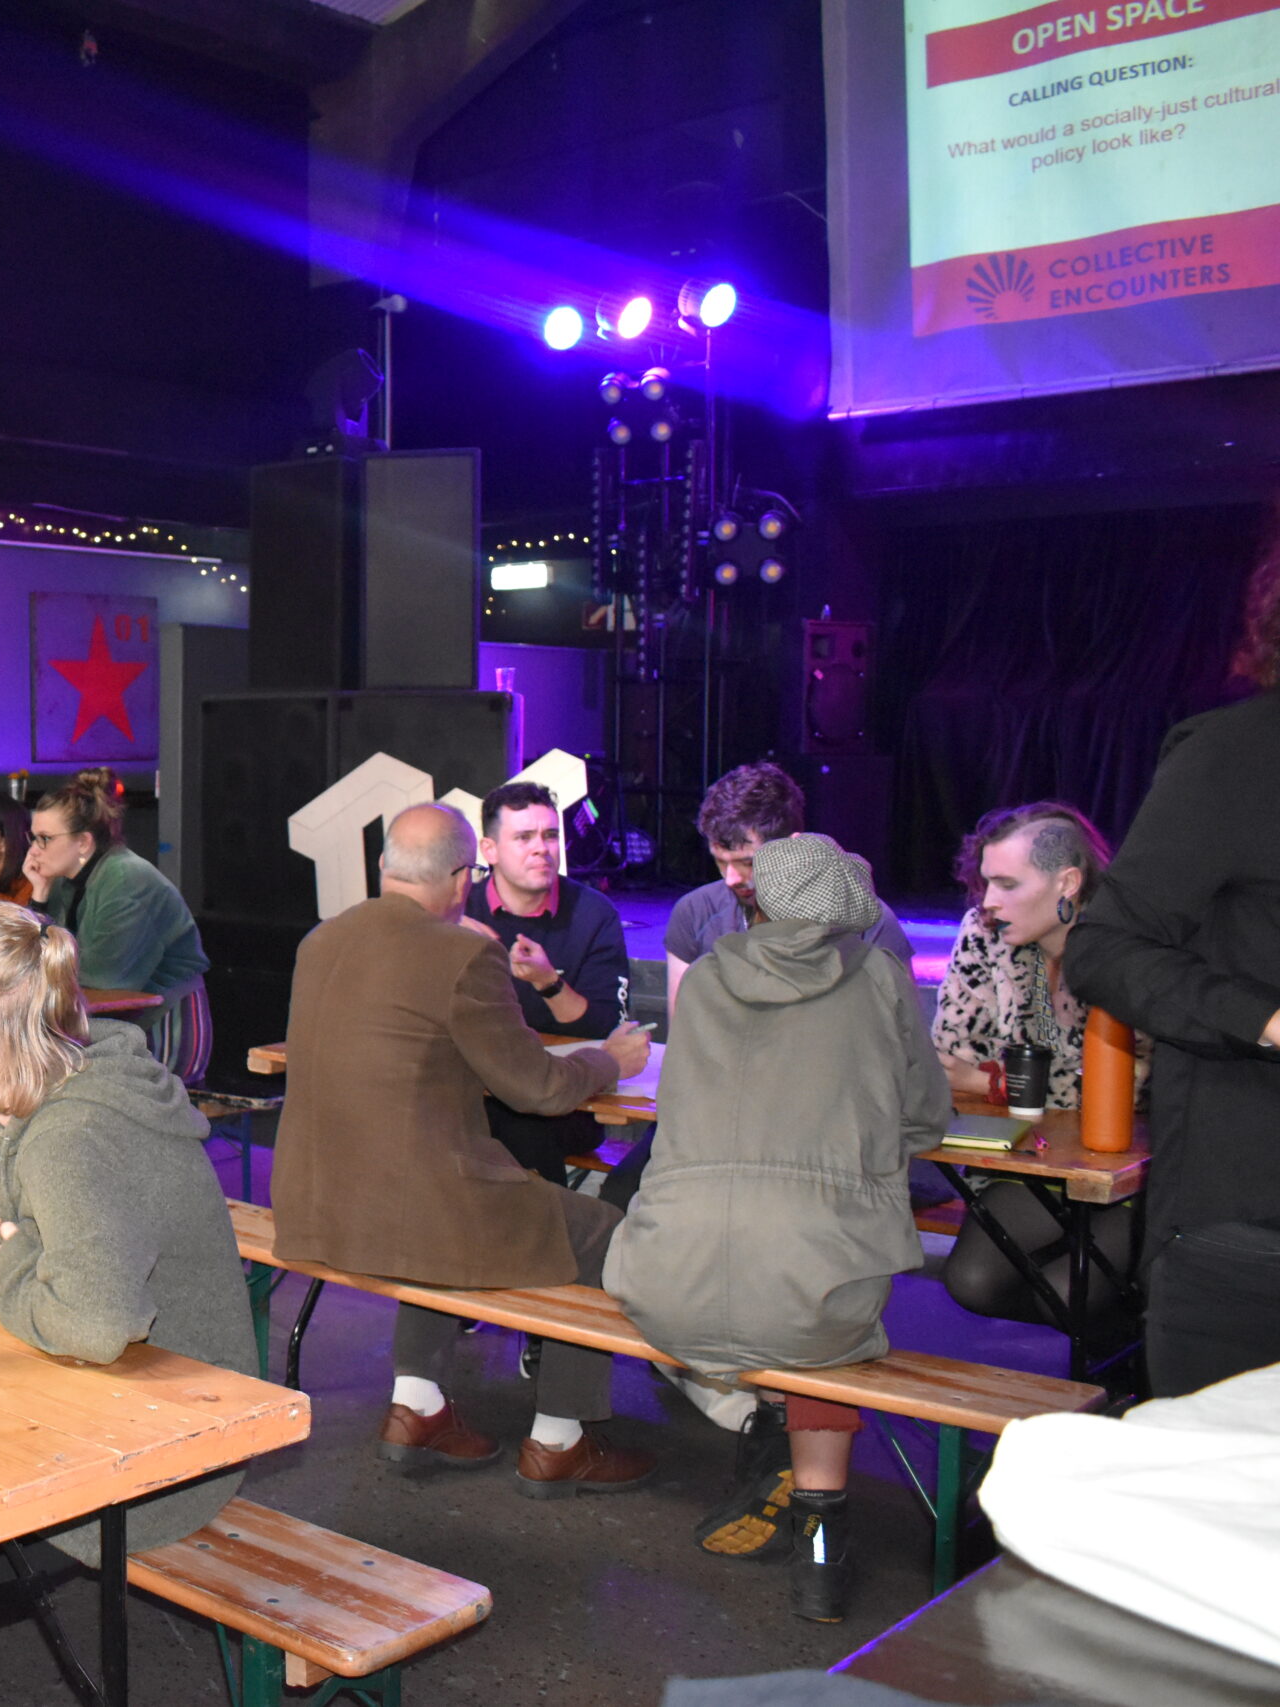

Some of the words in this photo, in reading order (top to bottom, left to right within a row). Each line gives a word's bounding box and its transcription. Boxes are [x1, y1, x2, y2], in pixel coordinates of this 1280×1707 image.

[1012, 10, 1096, 55] OPEN
[1106, 0, 1206, 31] SPACE
[1008, 76, 1083, 107] CALLING
[1088, 55, 1194, 86] QUESTION:
[947, 138, 996, 159] What
[1001, 125, 1057, 151] would
[1062, 122, 1074, 137] a
[1080, 96, 1198, 132] socially-just
[1203, 78, 1280, 109] cultural
[1031, 145, 1086, 173] policy
[1092, 132, 1132, 155] look
[1139, 123, 1186, 146] like?
[1048, 234, 1214, 279] COLLECTIVE
[1049, 263, 1231, 309] ENCOUNTERS
